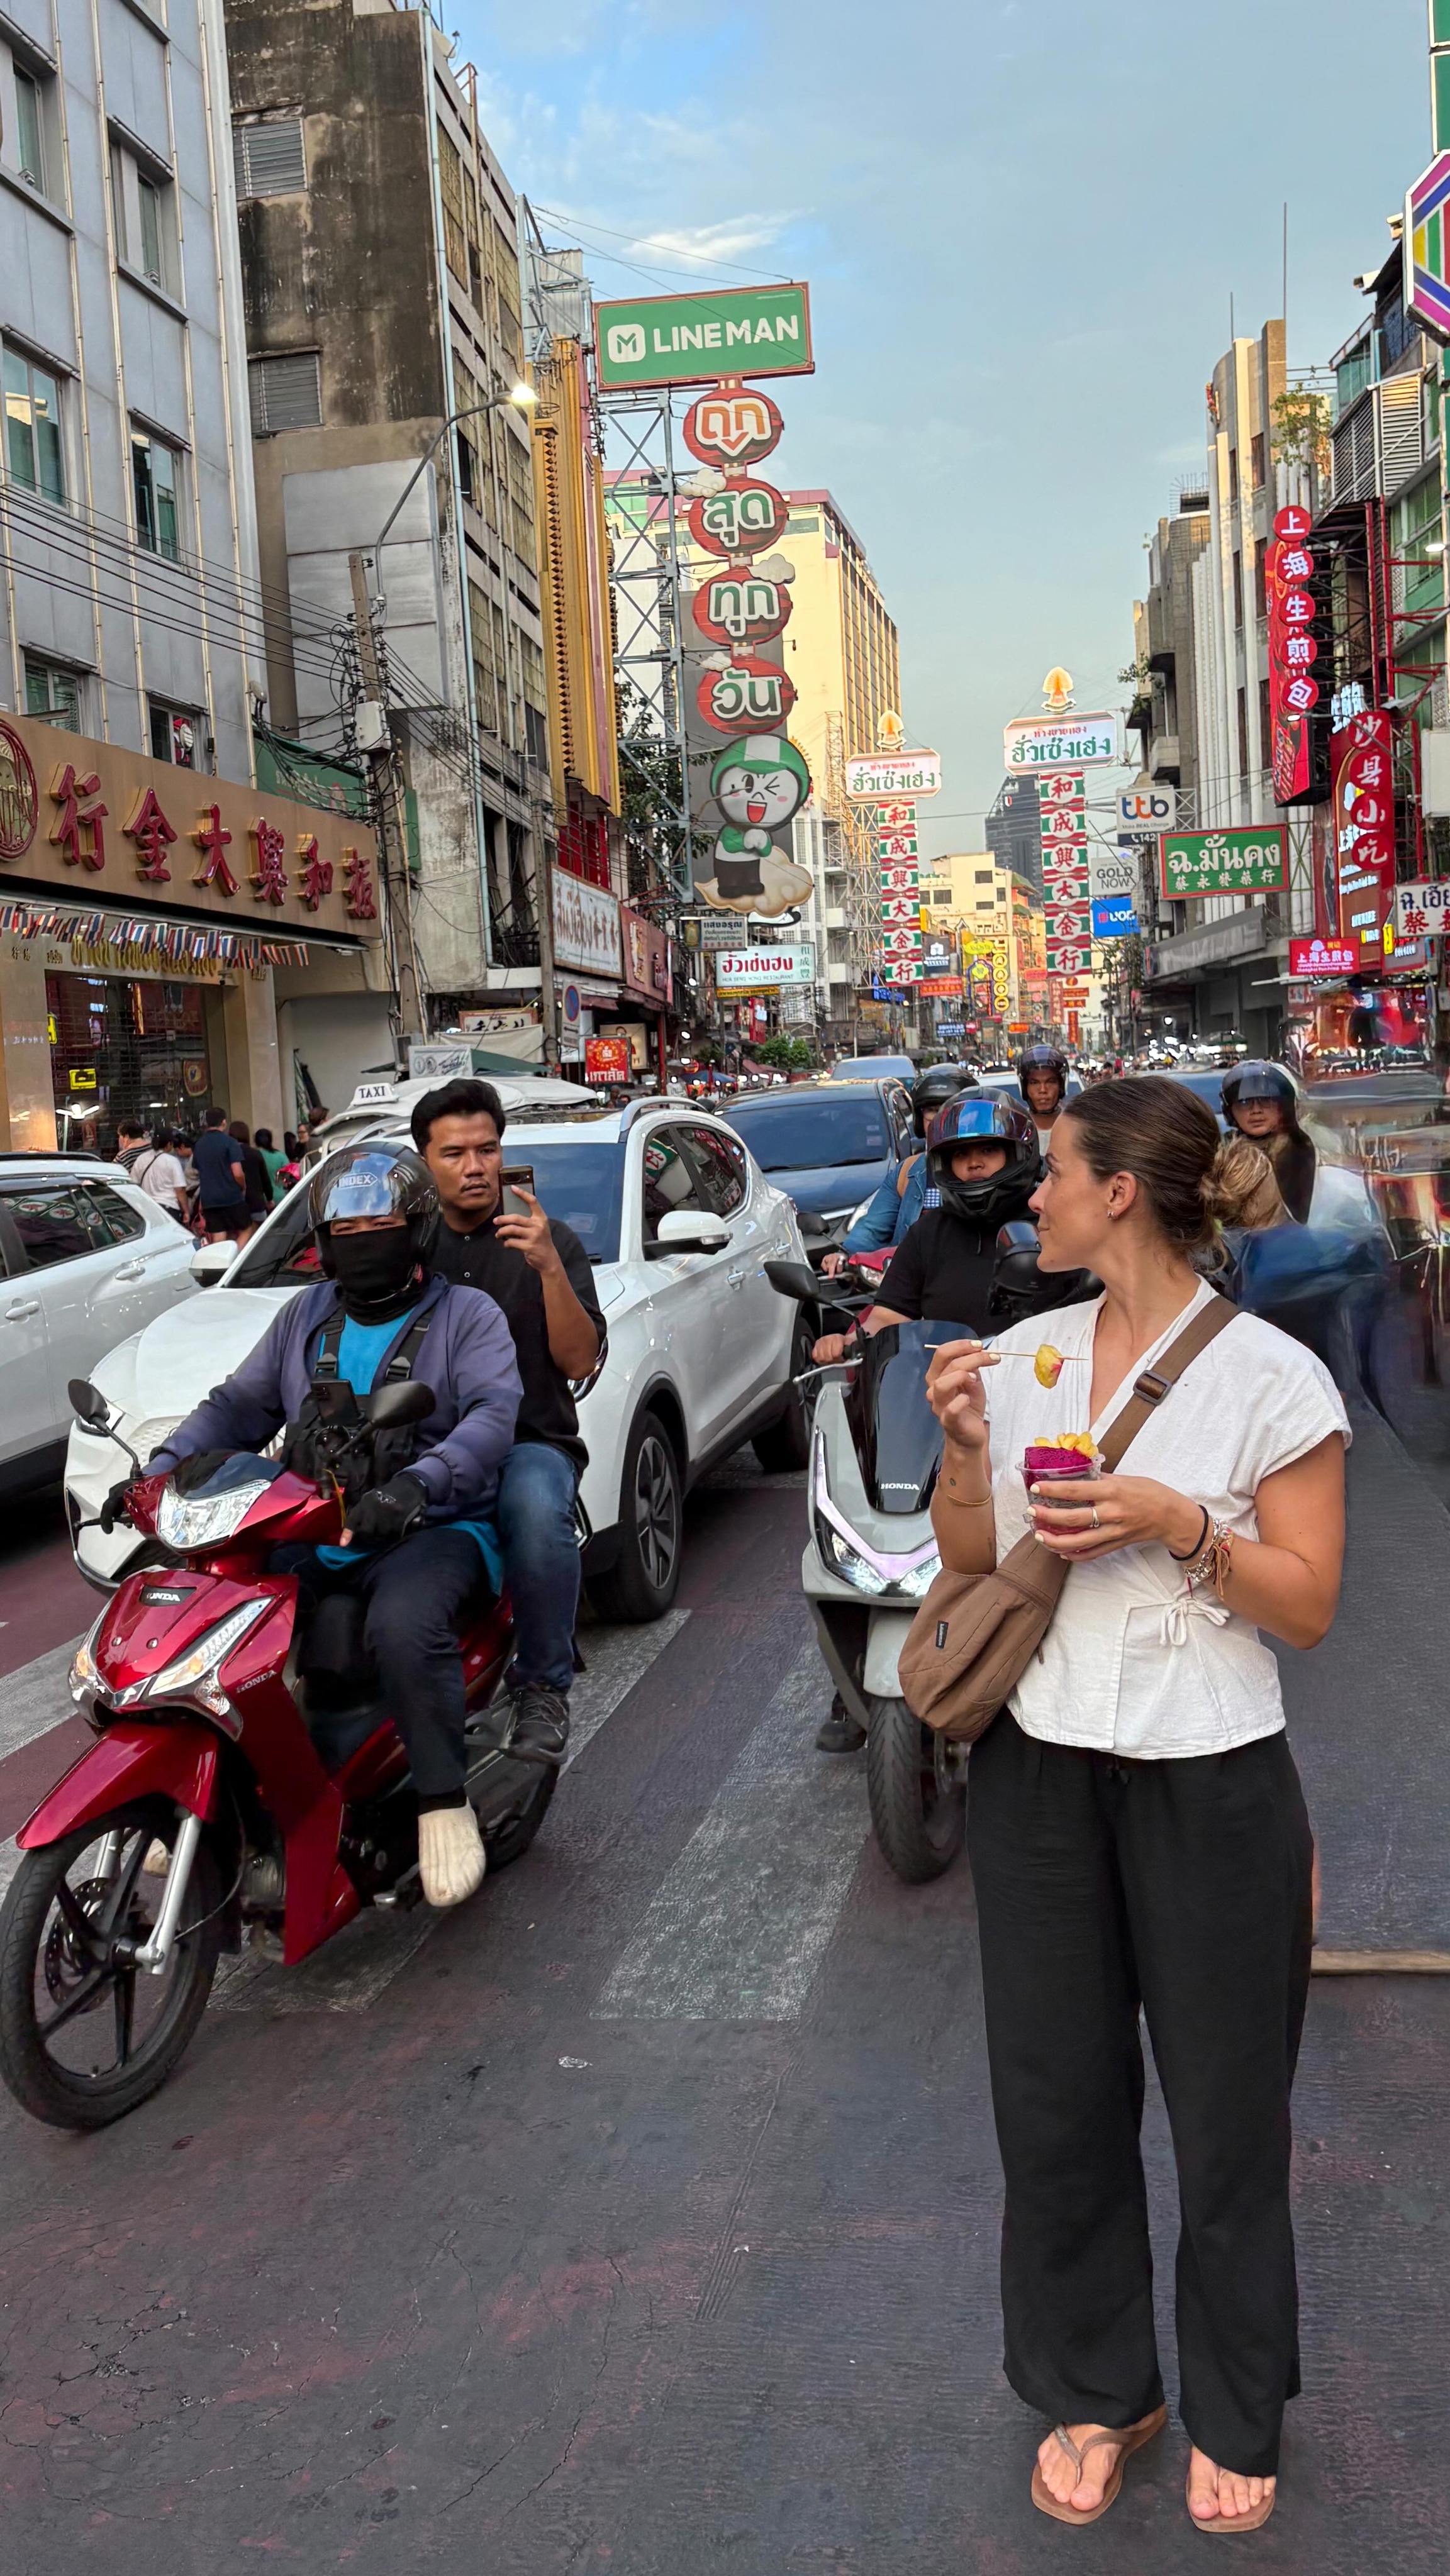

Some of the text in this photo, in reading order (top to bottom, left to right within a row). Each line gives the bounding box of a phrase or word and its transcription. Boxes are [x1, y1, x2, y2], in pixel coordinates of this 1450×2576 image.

[653, 322, 722, 353] LINE
[726, 315, 800, 345] MAN
[705, 491, 773, 545] สุด
[713, 582, 777, 635] ทุก
[1281, 511, 1313, 709] 上海生煎包
[1012, 735, 1111, 763] ฮั่วเซ่งเฮง
[852, 766, 935, 792] ฮั่วเซ่งเฮง
[1354, 716, 1388, 865] 沙县小吃
[1122, 794, 1169, 820] ttb
[1168, 834, 1280, 874] ฉ.มั่นคง
[1050, 777, 1081, 971] 和成興大金行
[1096, 867, 1132, 879] GOLD
[1101, 878, 1130, 889] NOW
[888, 806, 915, 982] 和成興大金行
[359, 1085, 386, 1099] TAXI
[339, 1174, 371, 1187] INDEX
[237, 1670, 277, 1694] HONDA
